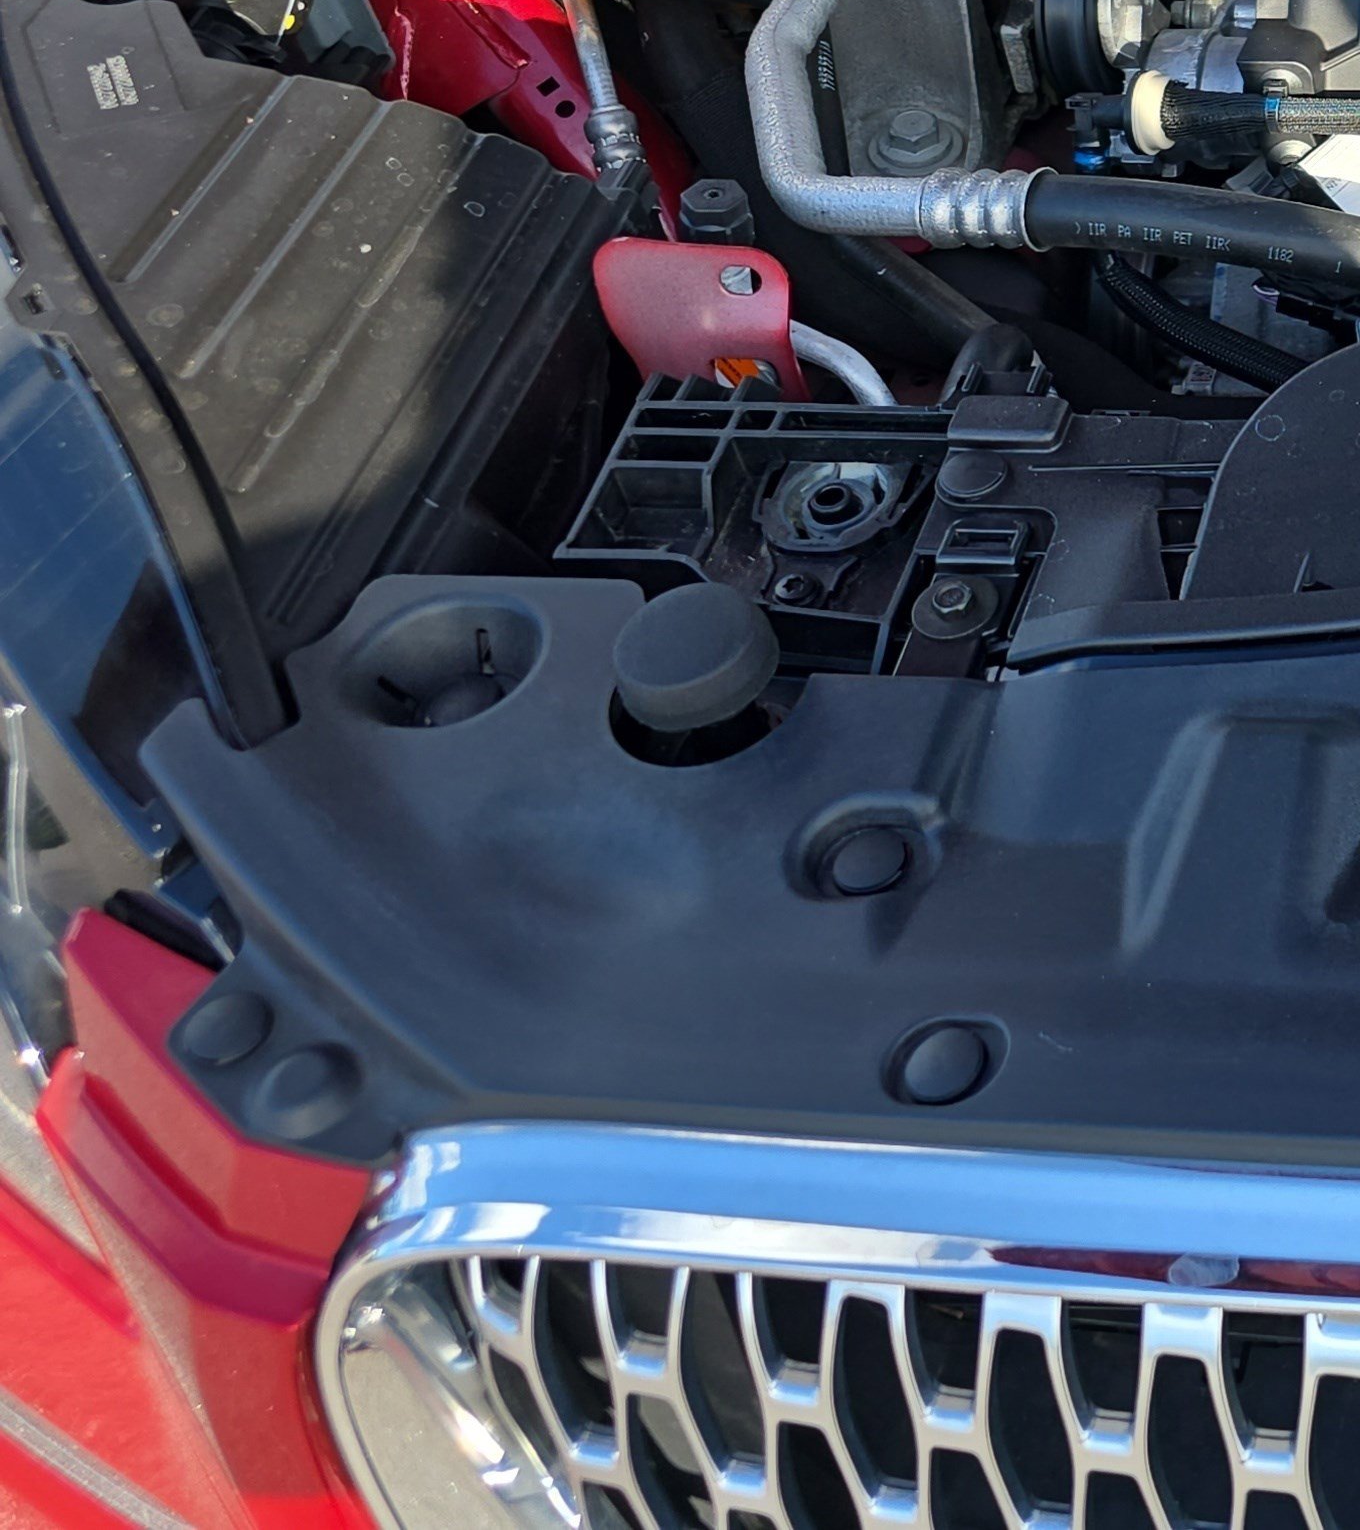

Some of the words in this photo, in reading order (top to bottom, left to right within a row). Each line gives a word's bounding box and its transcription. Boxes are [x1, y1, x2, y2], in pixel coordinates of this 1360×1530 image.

[1117, 224, 1132, 238] PA
[1173, 231, 1192, 246] PET
[1267, 246, 1294, 262] 1182
